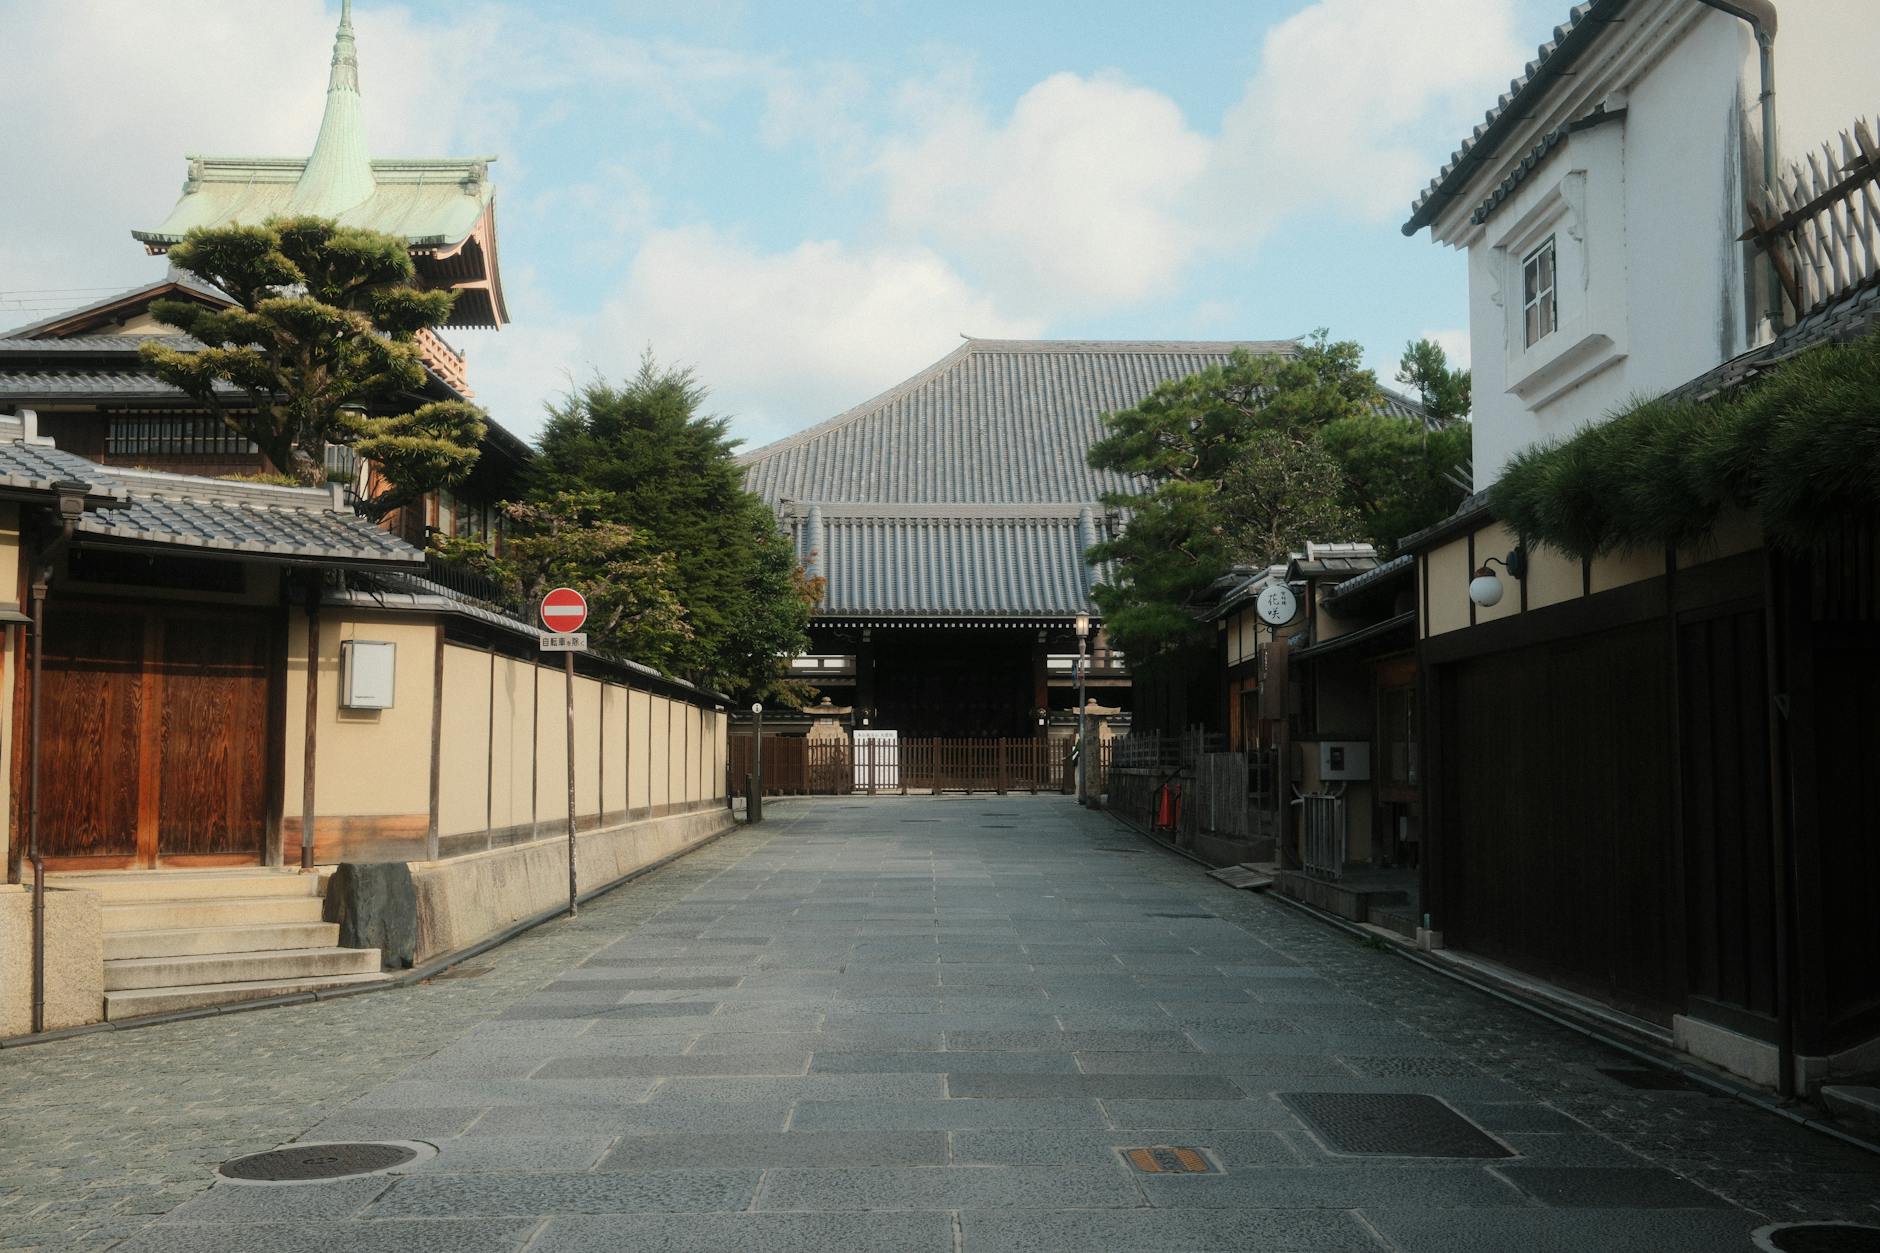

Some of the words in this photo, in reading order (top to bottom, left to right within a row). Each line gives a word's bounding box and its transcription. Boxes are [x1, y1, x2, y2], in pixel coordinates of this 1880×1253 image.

[1268, 593, 1280, 619] 花咲
[542, 637, 584, 647] 自転車を除く
